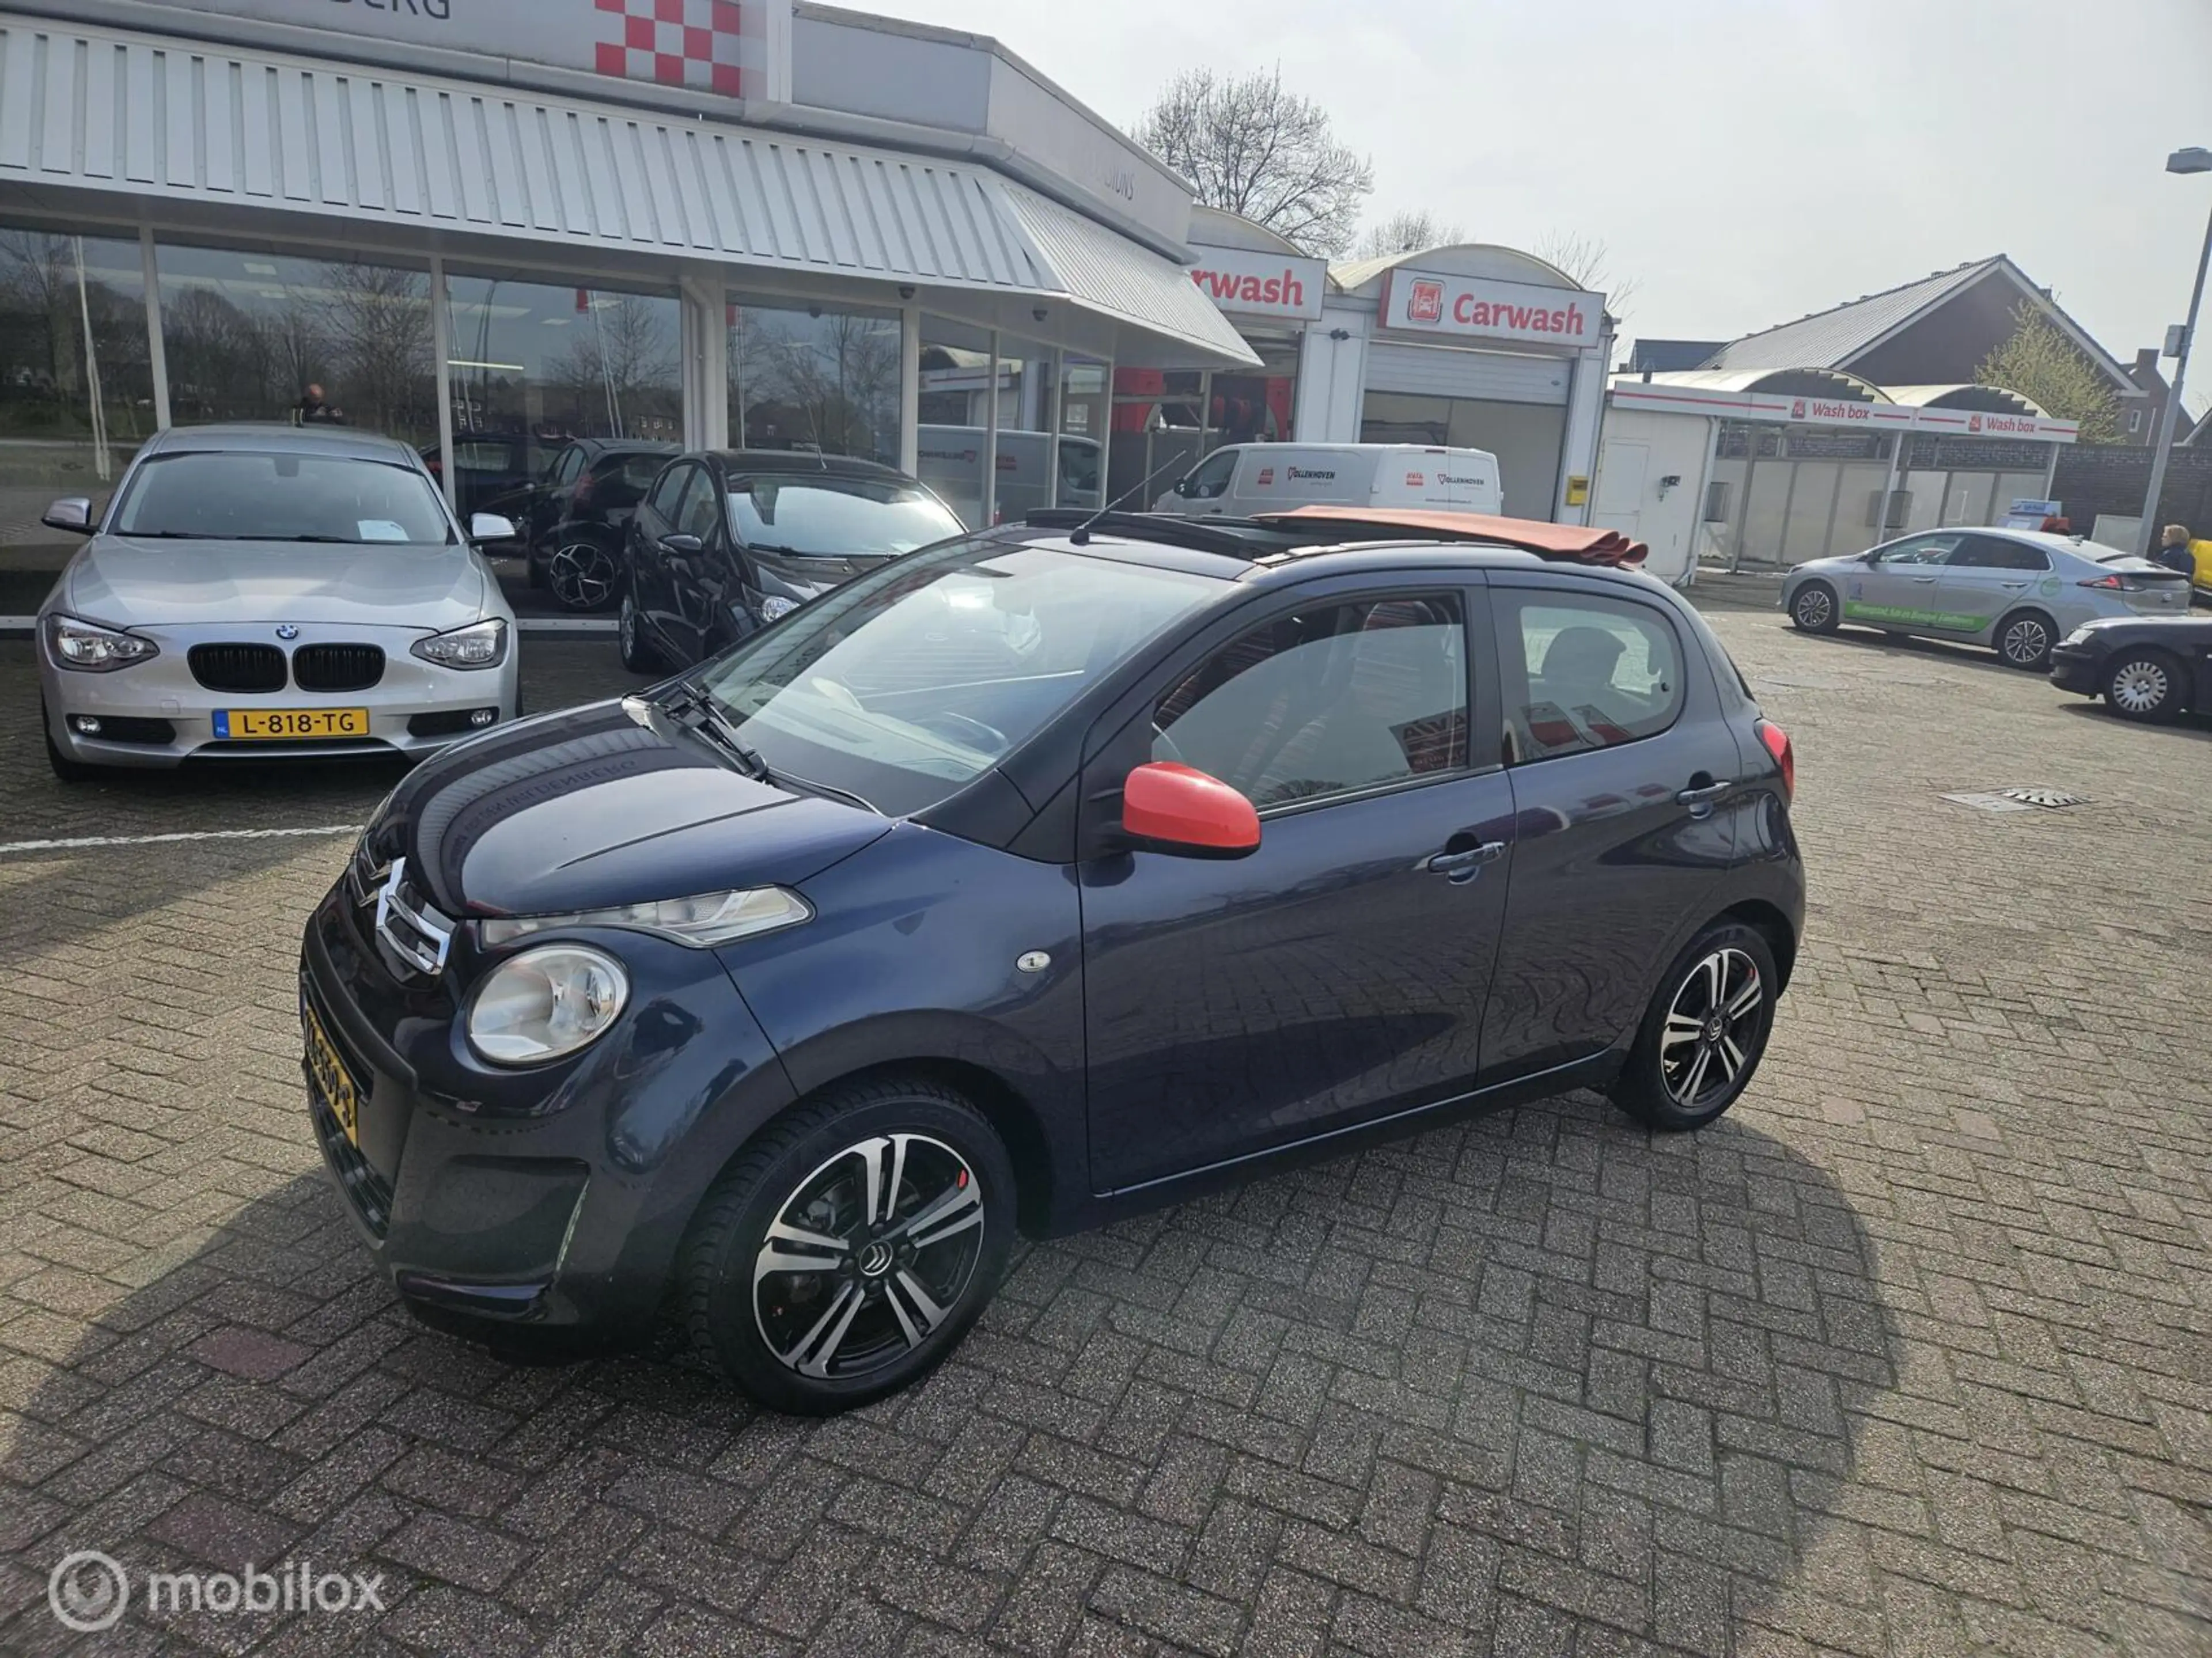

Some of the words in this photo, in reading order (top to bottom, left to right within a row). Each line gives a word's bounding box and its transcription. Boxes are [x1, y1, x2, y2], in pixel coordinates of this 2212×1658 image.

[1453, 293, 1584, 335] Carwash
[1813, 403, 1845, 418] Wash
[1847, 405, 1870, 419] box
[1987, 417, 2015, 431] Wash
[2017, 418, 2035, 433] box
[243, 713, 354, 734] L-818-TG
